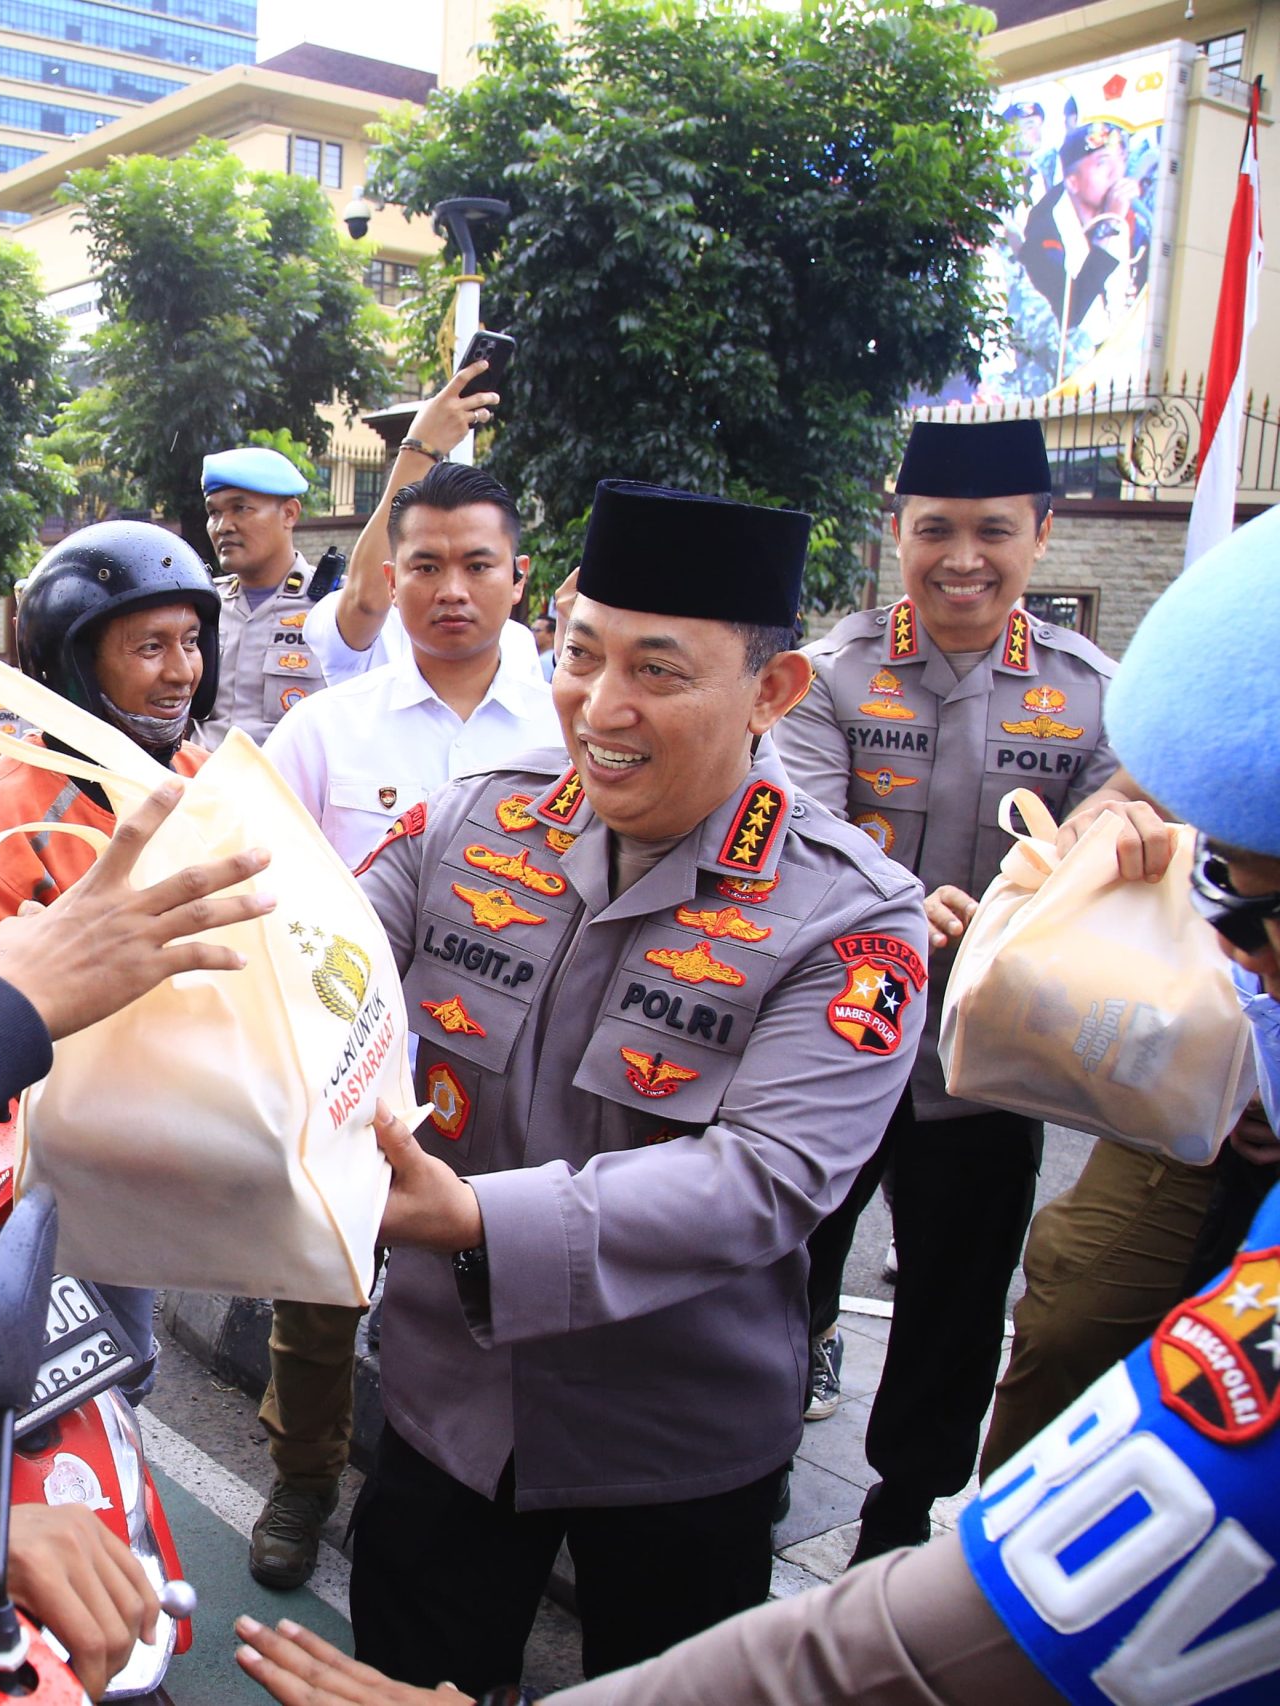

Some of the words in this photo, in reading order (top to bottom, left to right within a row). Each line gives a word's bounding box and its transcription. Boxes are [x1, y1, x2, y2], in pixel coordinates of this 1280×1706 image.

[847, 726, 929, 753] SYAHAR
[997, 748, 1083, 774] POLRI
[423, 925, 534, 988] L.SIGIT.P
[357, 989, 387, 1047] UNTUK
[620, 981, 734, 1045] POLRI
[834, 1005, 872, 1024] MABES
[872, 1018, 897, 1044] POLRI
[328, 1011, 398, 1131] MASYARAKAT
[1170, 1317, 1223, 1370] MABES
[1216, 1355, 1261, 1426] POLRI
